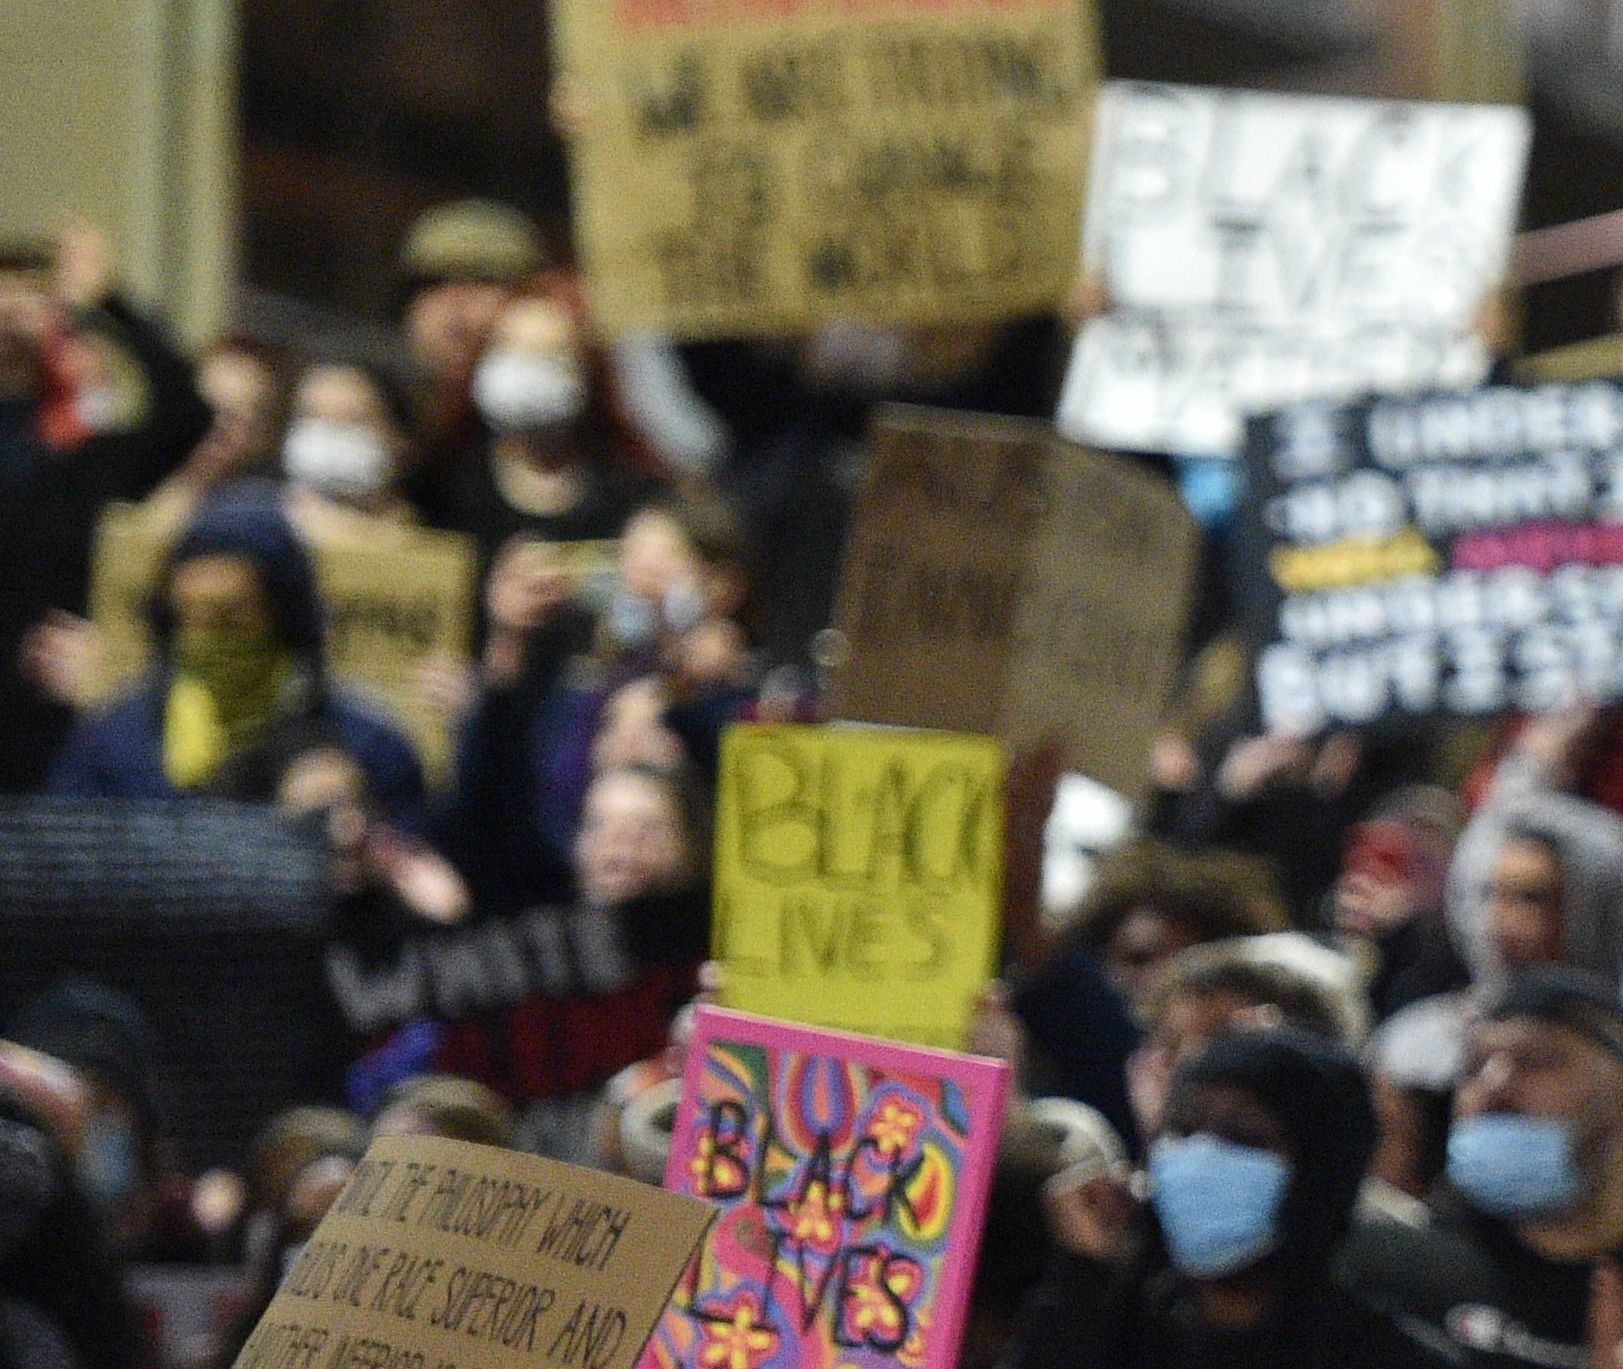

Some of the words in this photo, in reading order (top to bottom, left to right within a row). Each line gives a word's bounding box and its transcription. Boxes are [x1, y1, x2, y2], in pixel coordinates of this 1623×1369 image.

[702, 1097, 925, 1234] BLACK
[536, 1192, 637, 1272] WHICH
[372, 1251, 444, 1321] RACE
[430, 1266, 555, 1353] SUPERIOR
